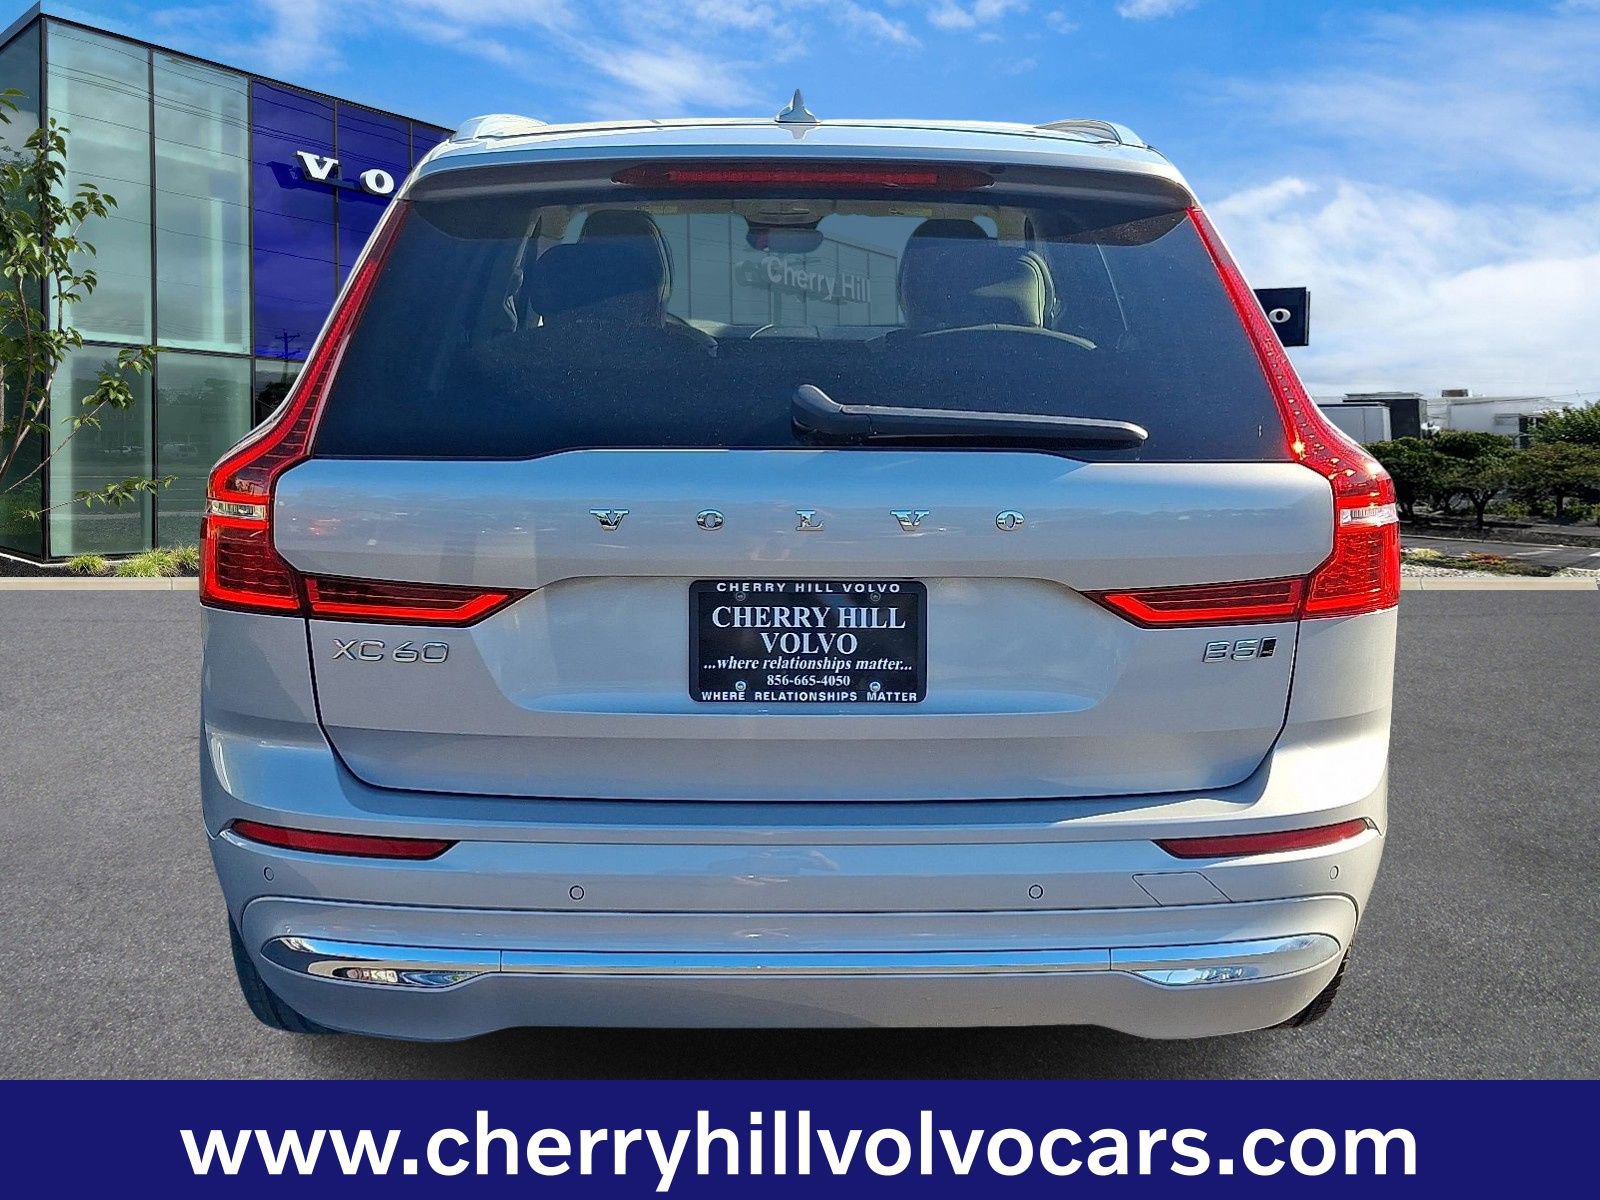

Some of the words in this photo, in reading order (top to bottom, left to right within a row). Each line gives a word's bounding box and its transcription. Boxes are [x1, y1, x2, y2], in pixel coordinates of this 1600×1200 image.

[767, 256, 835, 300] Cherry
[841, 272, 871, 302] Hill
[590, 508, 1025, 532] VOLVO
[717, 582, 786, 593] CHERRY
[795, 583, 834, 593] HILL
[842, 583, 901, 593] VOLVO
[712, 606, 831, 628] CHERRY
[837, 606, 906, 629] HILL
[760, 632, 858, 655] VOLVO
[1202, 637, 1258, 663] B5
[762, 656, 852, 673] relationships
[766, 674, 851, 687] 856-665-4050
[701, 691, 746, 701] WHERE
[754, 691, 858, 702] RELATIONSHIPS
[866, 692, 918, 702] MATTER
